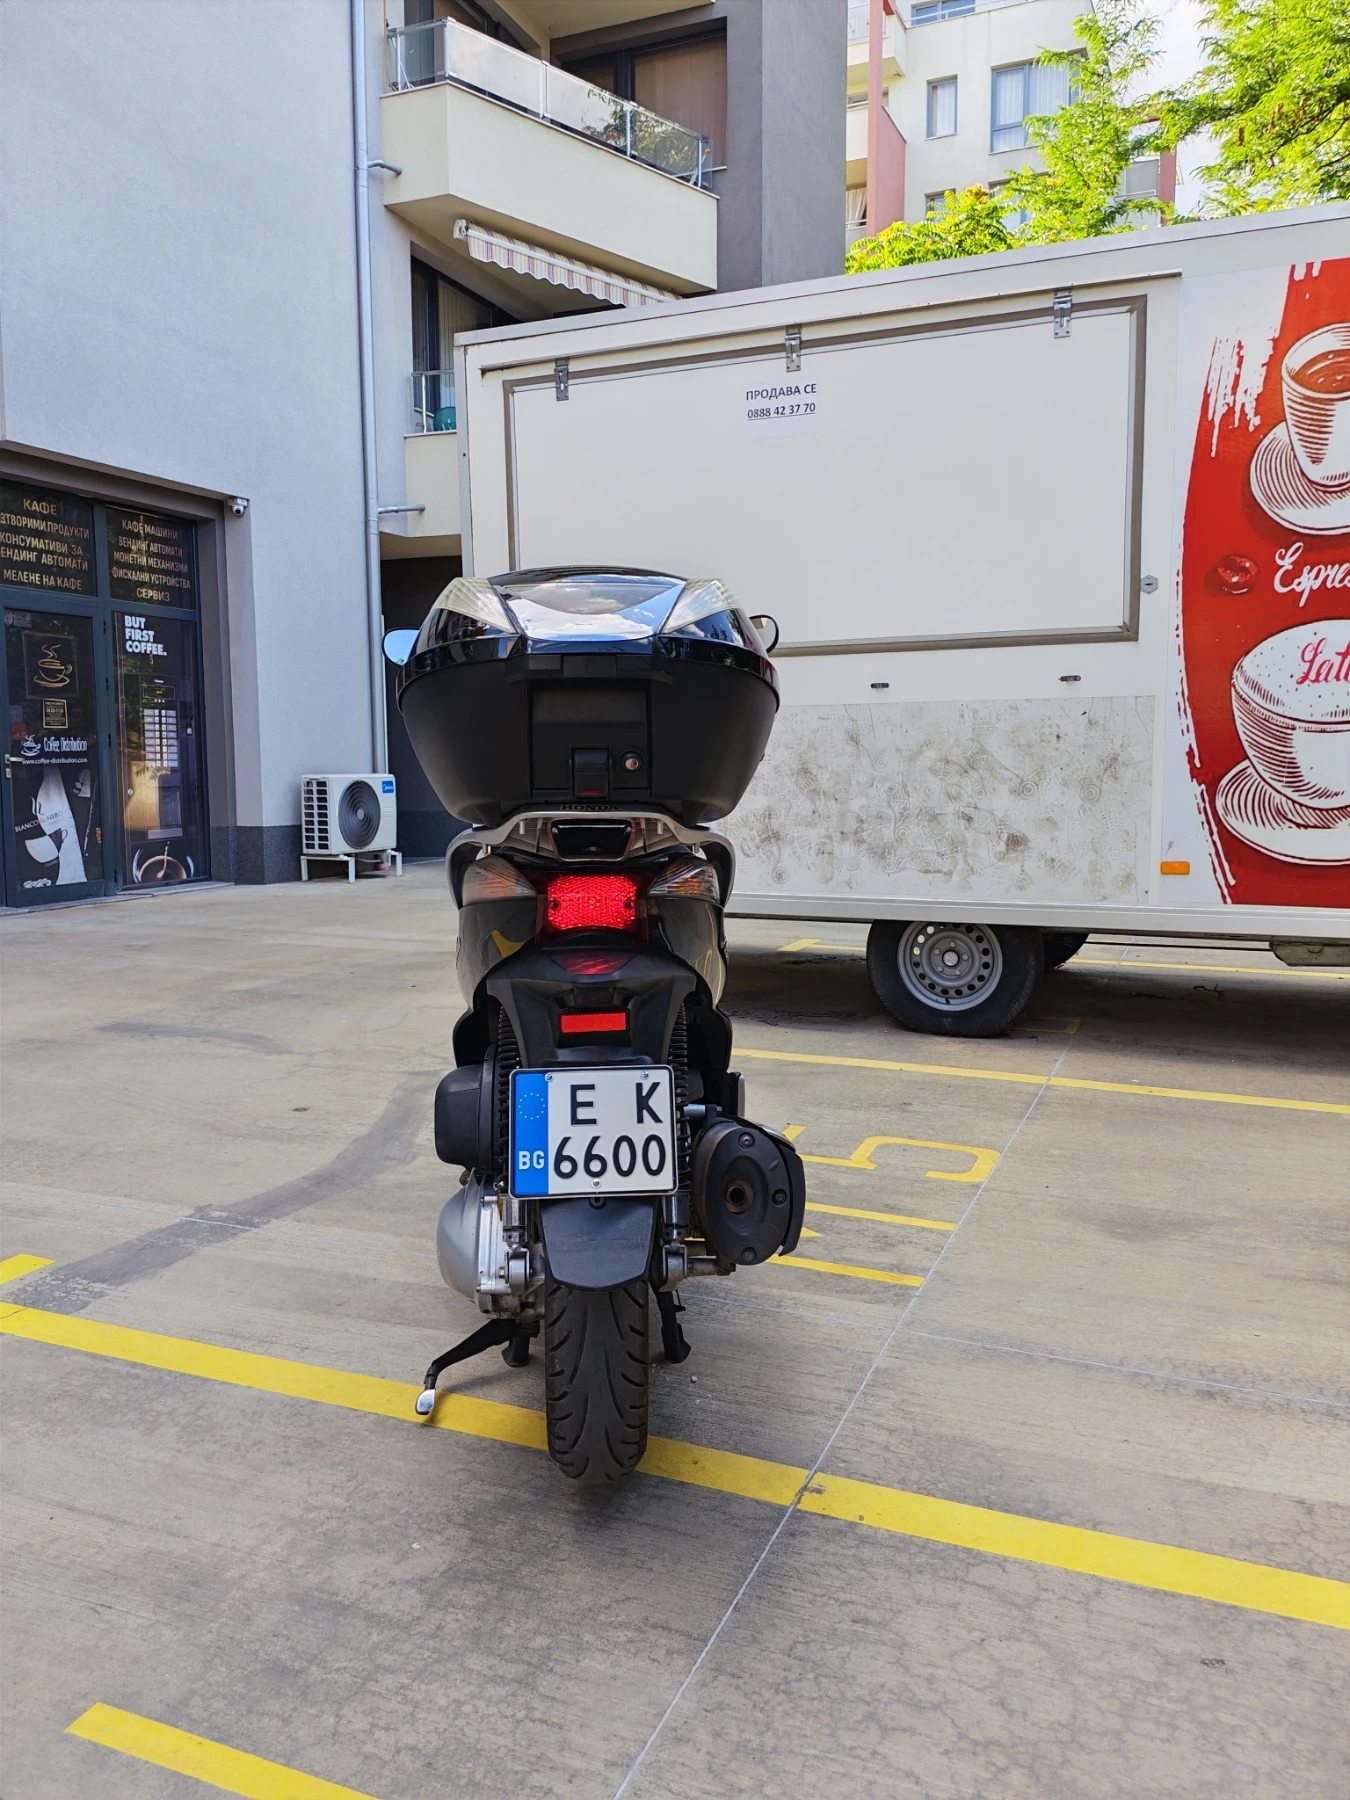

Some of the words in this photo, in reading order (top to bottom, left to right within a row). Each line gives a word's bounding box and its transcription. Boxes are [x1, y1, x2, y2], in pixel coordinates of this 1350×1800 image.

[746, 386, 801, 400] ПРОДАВА
[804, 384, 816, 394] СЕ
[747, 407, 771, 419] 0888
[774, 406, 785, 415] 42
[789, 404, 800, 414] 37
[804, 403, 815, 412] 70
[23, 498, 57, 515] КАФЕ
[47, 521, 90, 540] ПРОДУКТИ
[122, 519, 144, 533] КАФЕ
[144, 523, 178, 540] МАШИНИ
[0, 532, 68, 554] КОНСУМАТИВИ
[71, 544, 83, 556] ЗА
[118, 535, 149, 551] ВЕНДИНГ
[149, 541, 183, 557] АВТОМАТИ
[41, 553, 88, 571] АВТОМАТИ
[113, 550, 147, 566] МОНЕТНИ
[147, 556, 189, 574] МЕХАНИЗМИ
[3, 568, 41, 585] МЕЛЕНЕ
[42, 574, 56, 587] НА
[57, 576, 82, 590] КАФЕ
[111, 566, 150, 582] ФИСКАЛНИ
[150, 573, 191, 589] УСТРОЙСТВА
[136, 587, 170, 602] СЕРВИЗ
[124, 615, 146, 629] BUT
[125, 627, 155, 642] FIRST
[125, 640, 168, 656] COFFEE.
[43, 736, 60, 752] Coffee
[60, 736, 88, 752] Distribution
[22, 757, 88, 765] www.coffee-distribution.com
[570, 1084, 597, 1126] E
[635, 1082, 664, 1124] K
[518, 1150, 545, 1170] BG
[553, 1134, 667, 1179] 6600
